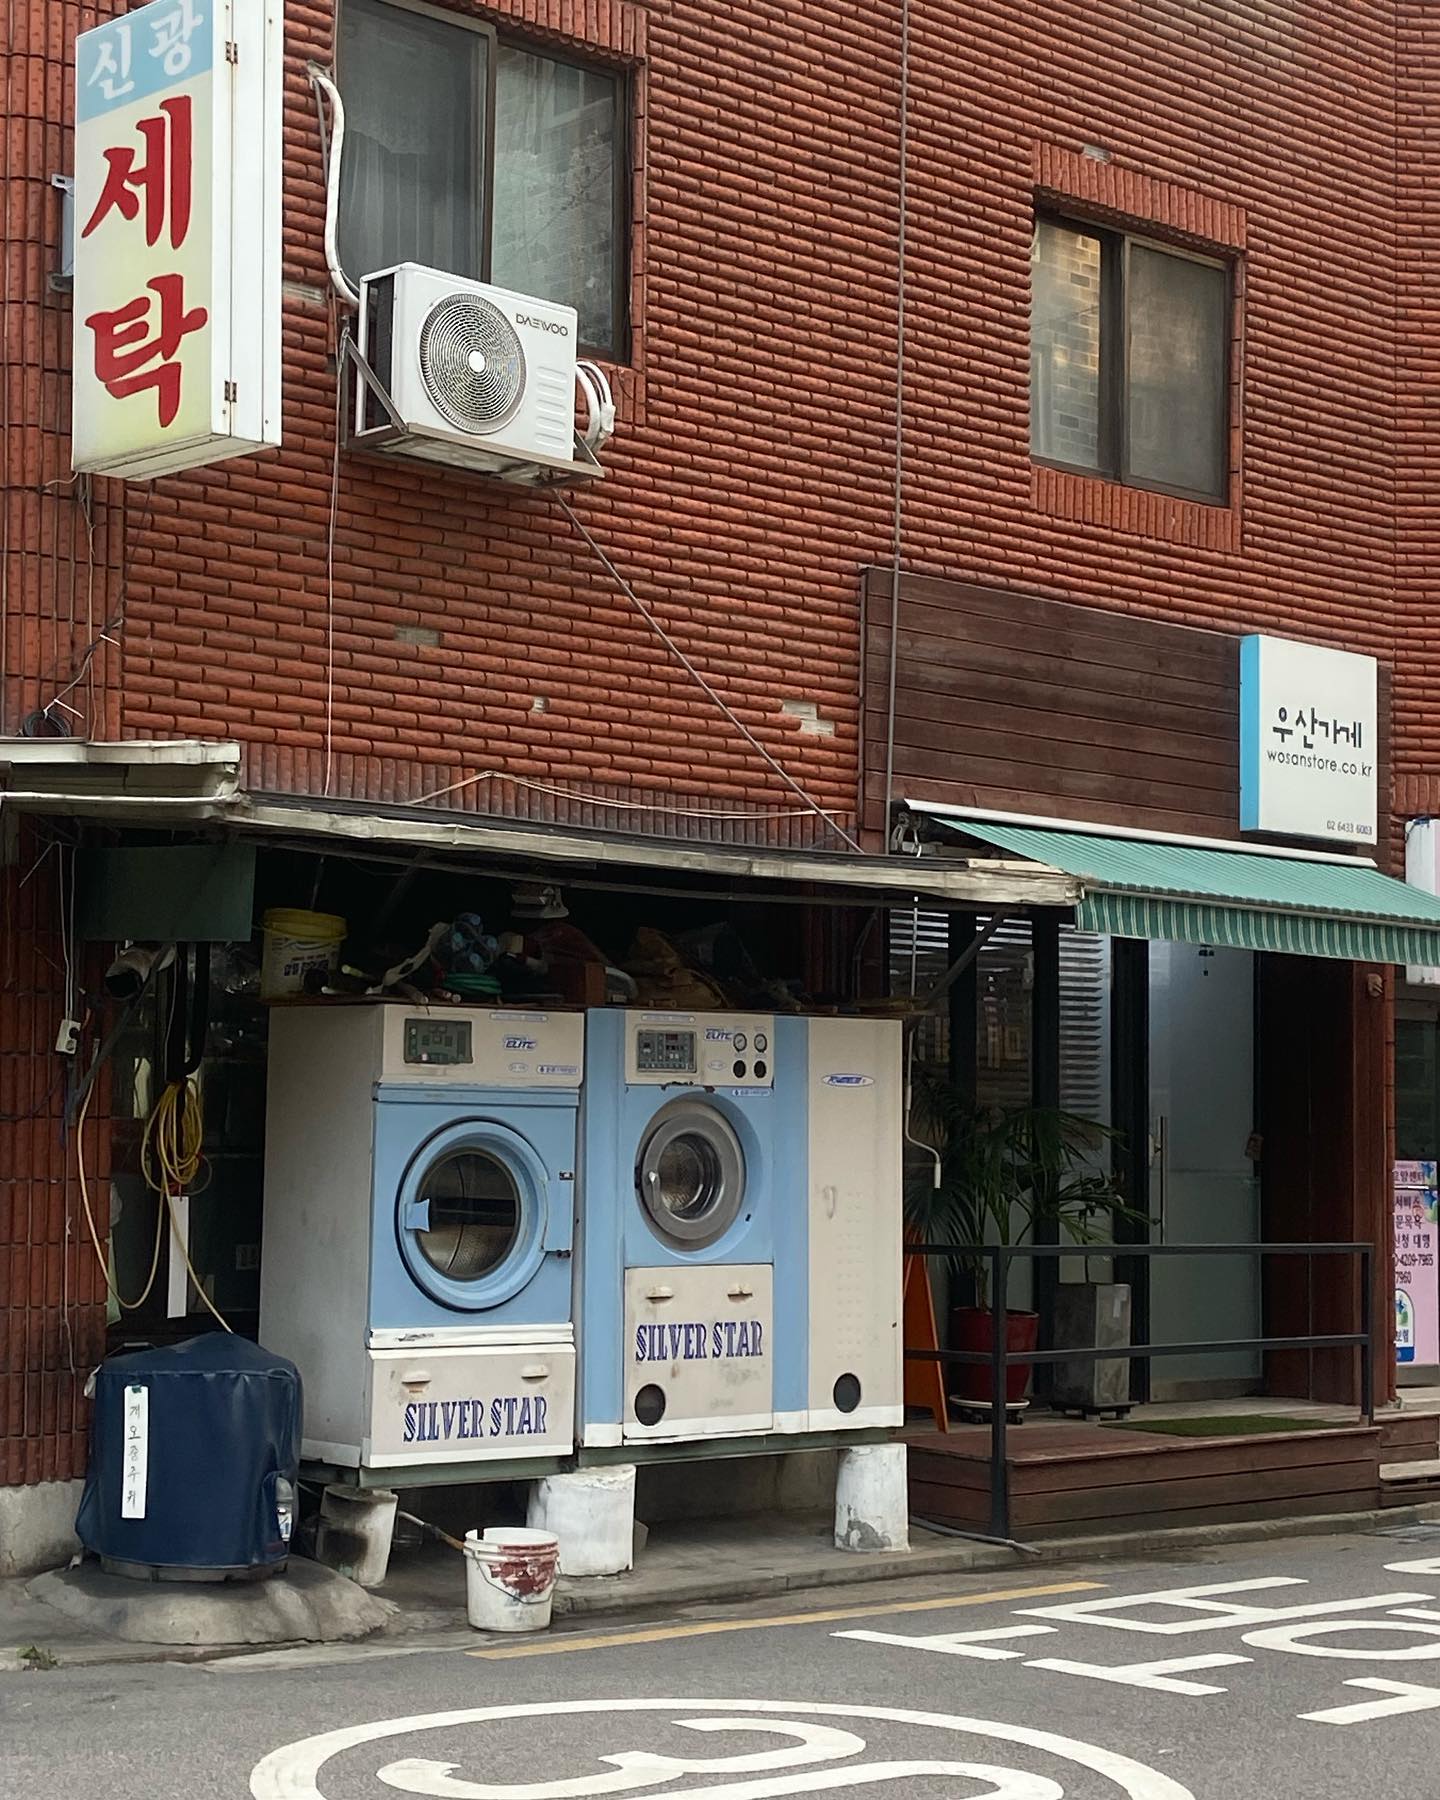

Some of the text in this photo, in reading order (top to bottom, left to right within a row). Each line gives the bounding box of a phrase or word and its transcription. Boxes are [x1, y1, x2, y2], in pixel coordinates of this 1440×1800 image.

[87, 0, 204, 101] 신광
[81, 94, 208, 428] 세탁
[515, 312, 569, 337] DAEWOO
[1272, 706, 1362, 750] 우산가게
[1267, 748, 1373, 777] wosanstore.co.kr
[1326, 819, 1336, 831] 02
[1412, 1233, 1431, 1250] 대행
[635, 1320, 764, 1363] SILVER STAR
[402, 1395, 548, 1442] SILVER STAR
